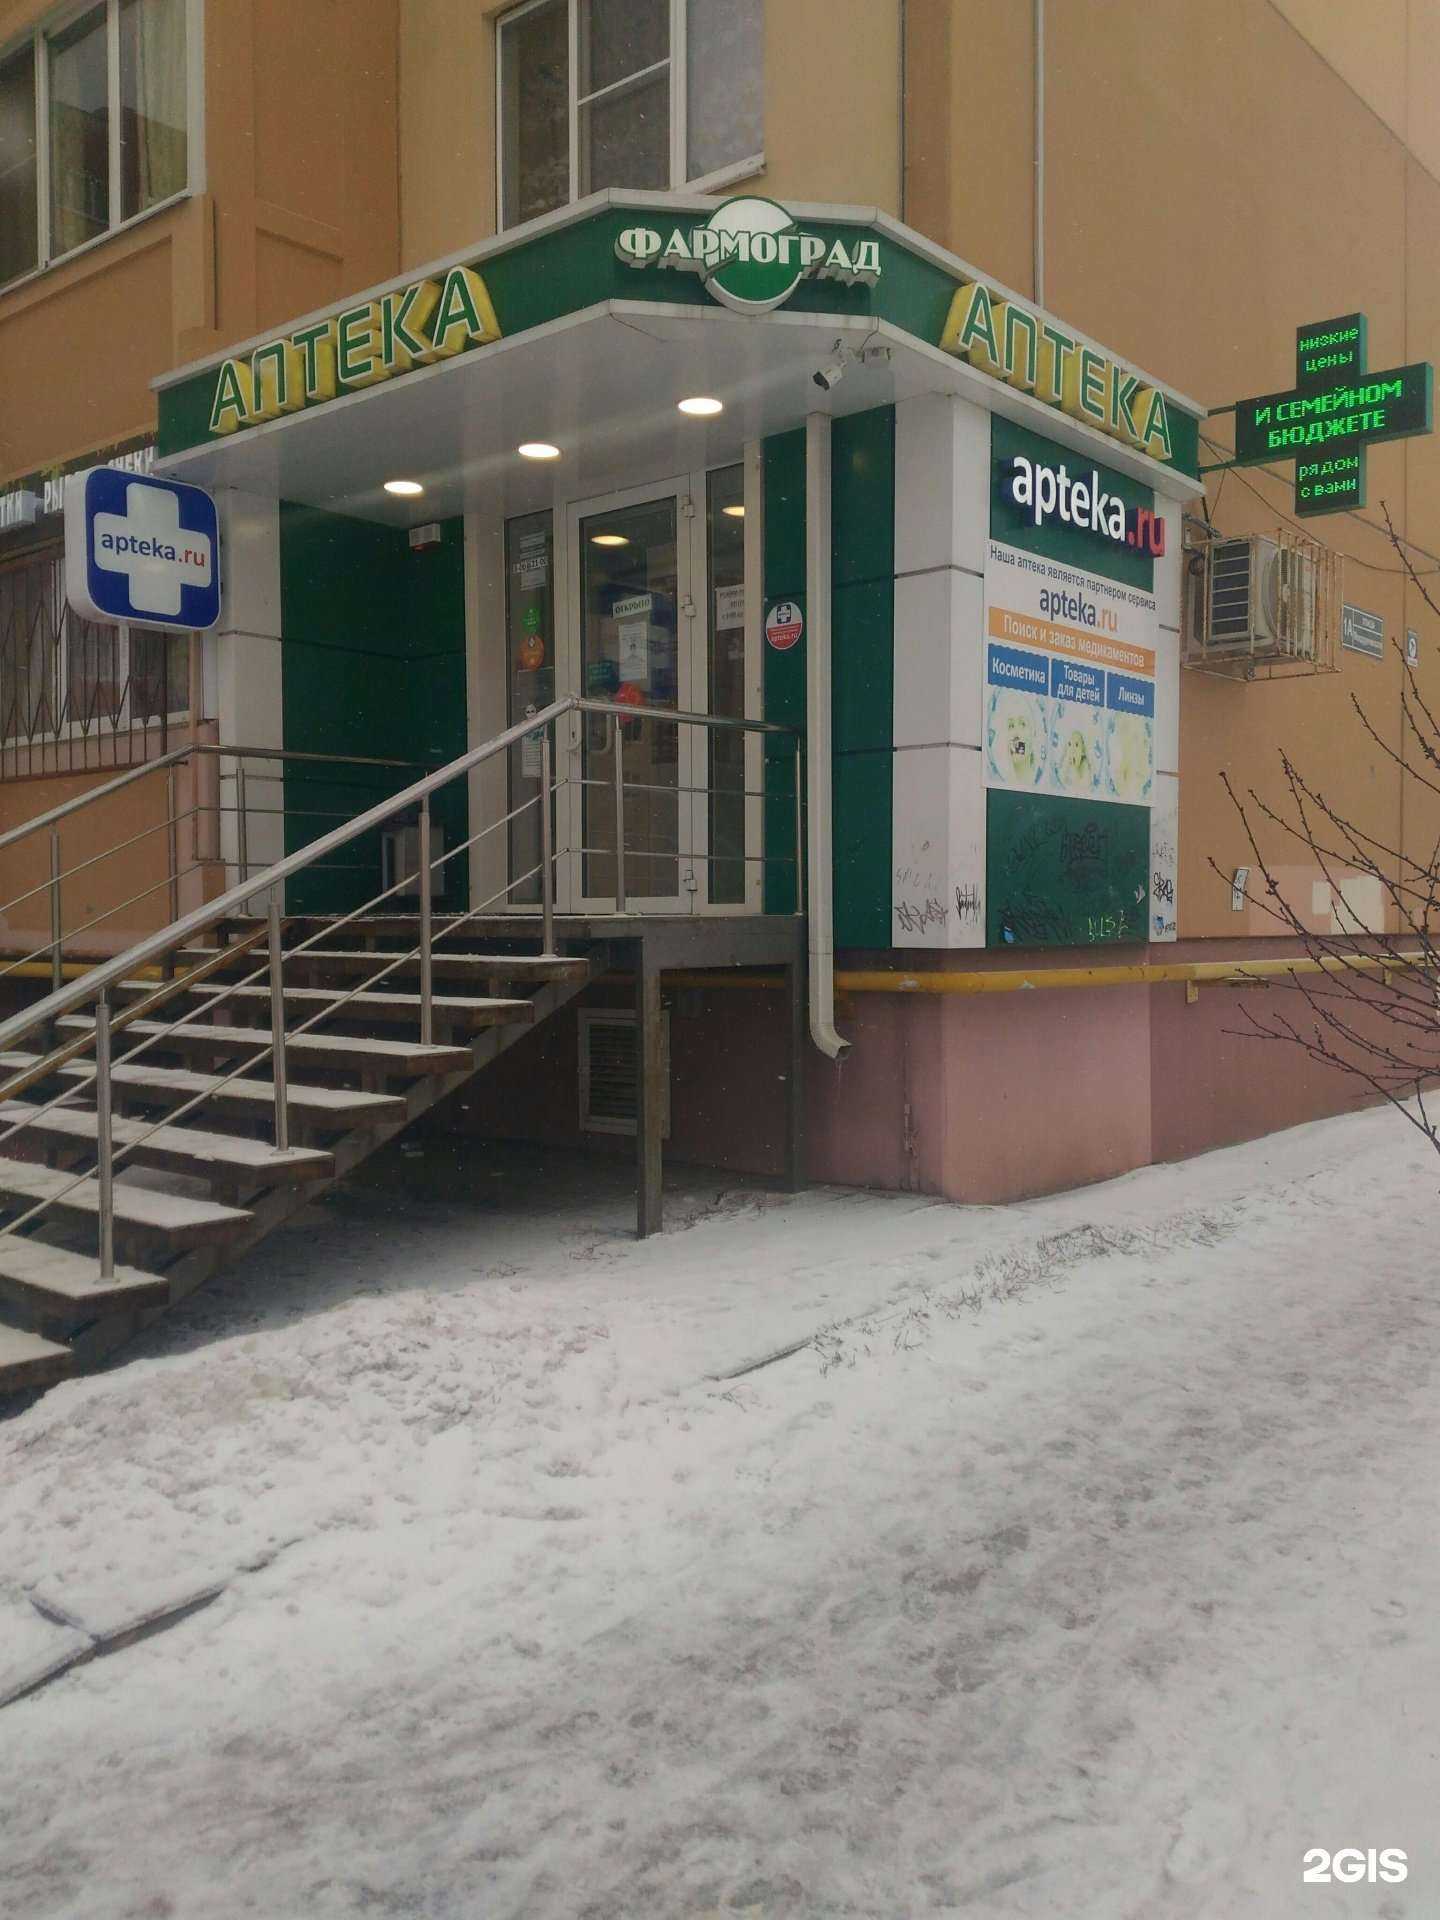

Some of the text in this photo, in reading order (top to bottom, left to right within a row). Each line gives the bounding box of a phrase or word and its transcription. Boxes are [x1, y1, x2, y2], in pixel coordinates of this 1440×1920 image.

[615, 226, 882, 277] ФАРМОГРАД
[208, 265, 502, 434] АПТЕКА
[1300, 328, 1359, 351] низкие
[940, 281, 1173, 461] АПТЕКА
[1306, 351, 1353, 371] цены
[1255, 379, 1403, 426] И СЕМЕЙНОМ
[1268, 409, 1386, 448] БЮДЖЕТЕ
[1299, 456, 1359, 481] рядом
[1301, 478, 1357, 498] с вами
[1012, 456, 1166, 558] apteka.ru
[101, 533, 205, 567] apteka.ru
[990, 545, 1157, 611] Наша аптека является партнером сервиса
[1039, 588, 1118, 633] apteka.ru
[1003, 614, 1145, 668] Поиск и заказ медикаментов
[992, 657, 1046, 684] Косметика
[1064, 665, 1095, 687] Товары
[1057, 683, 1101, 704] для детей
[1118, 687, 1145, 706] Линзы
